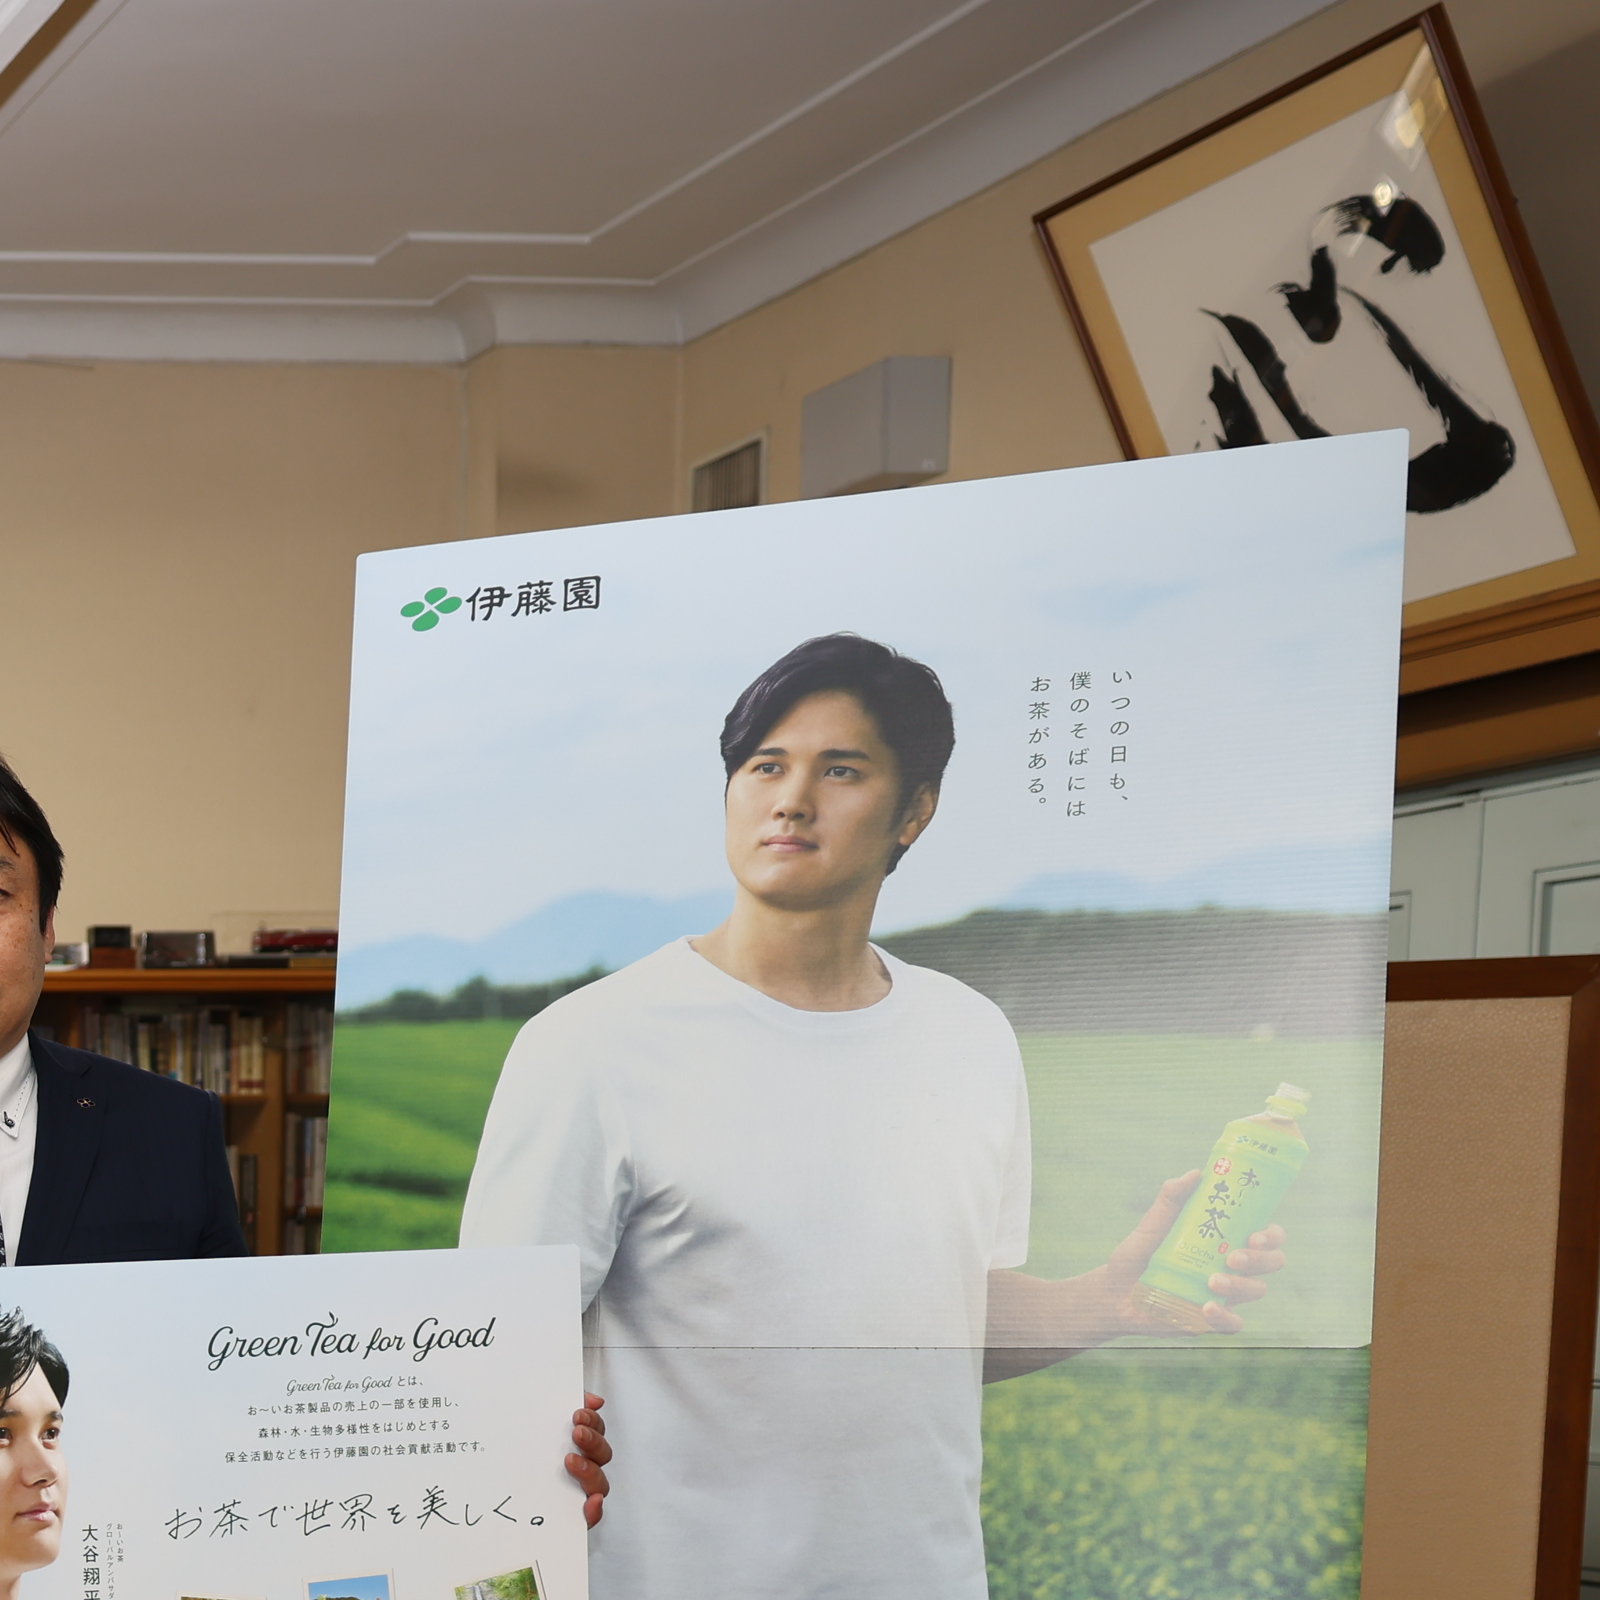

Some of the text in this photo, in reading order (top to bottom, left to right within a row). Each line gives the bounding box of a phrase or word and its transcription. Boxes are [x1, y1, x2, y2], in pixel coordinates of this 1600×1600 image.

[465, 575, 602, 623] 伊藤園
[1028, 676, 1051, 804] お茶がある。
[1066, 671, 1092, 817] 僕のそばには
[1109, 670, 1133, 801] いつの日も、
[207, 1311, 497, 1371] Green Tea for Good
[286, 1379, 322, 1396] Green
[322, 1374, 343, 1391] Tea
[361, 1375, 393, 1394] Good
[165, 1485, 545, 1540] お茶で世界を美しく。
